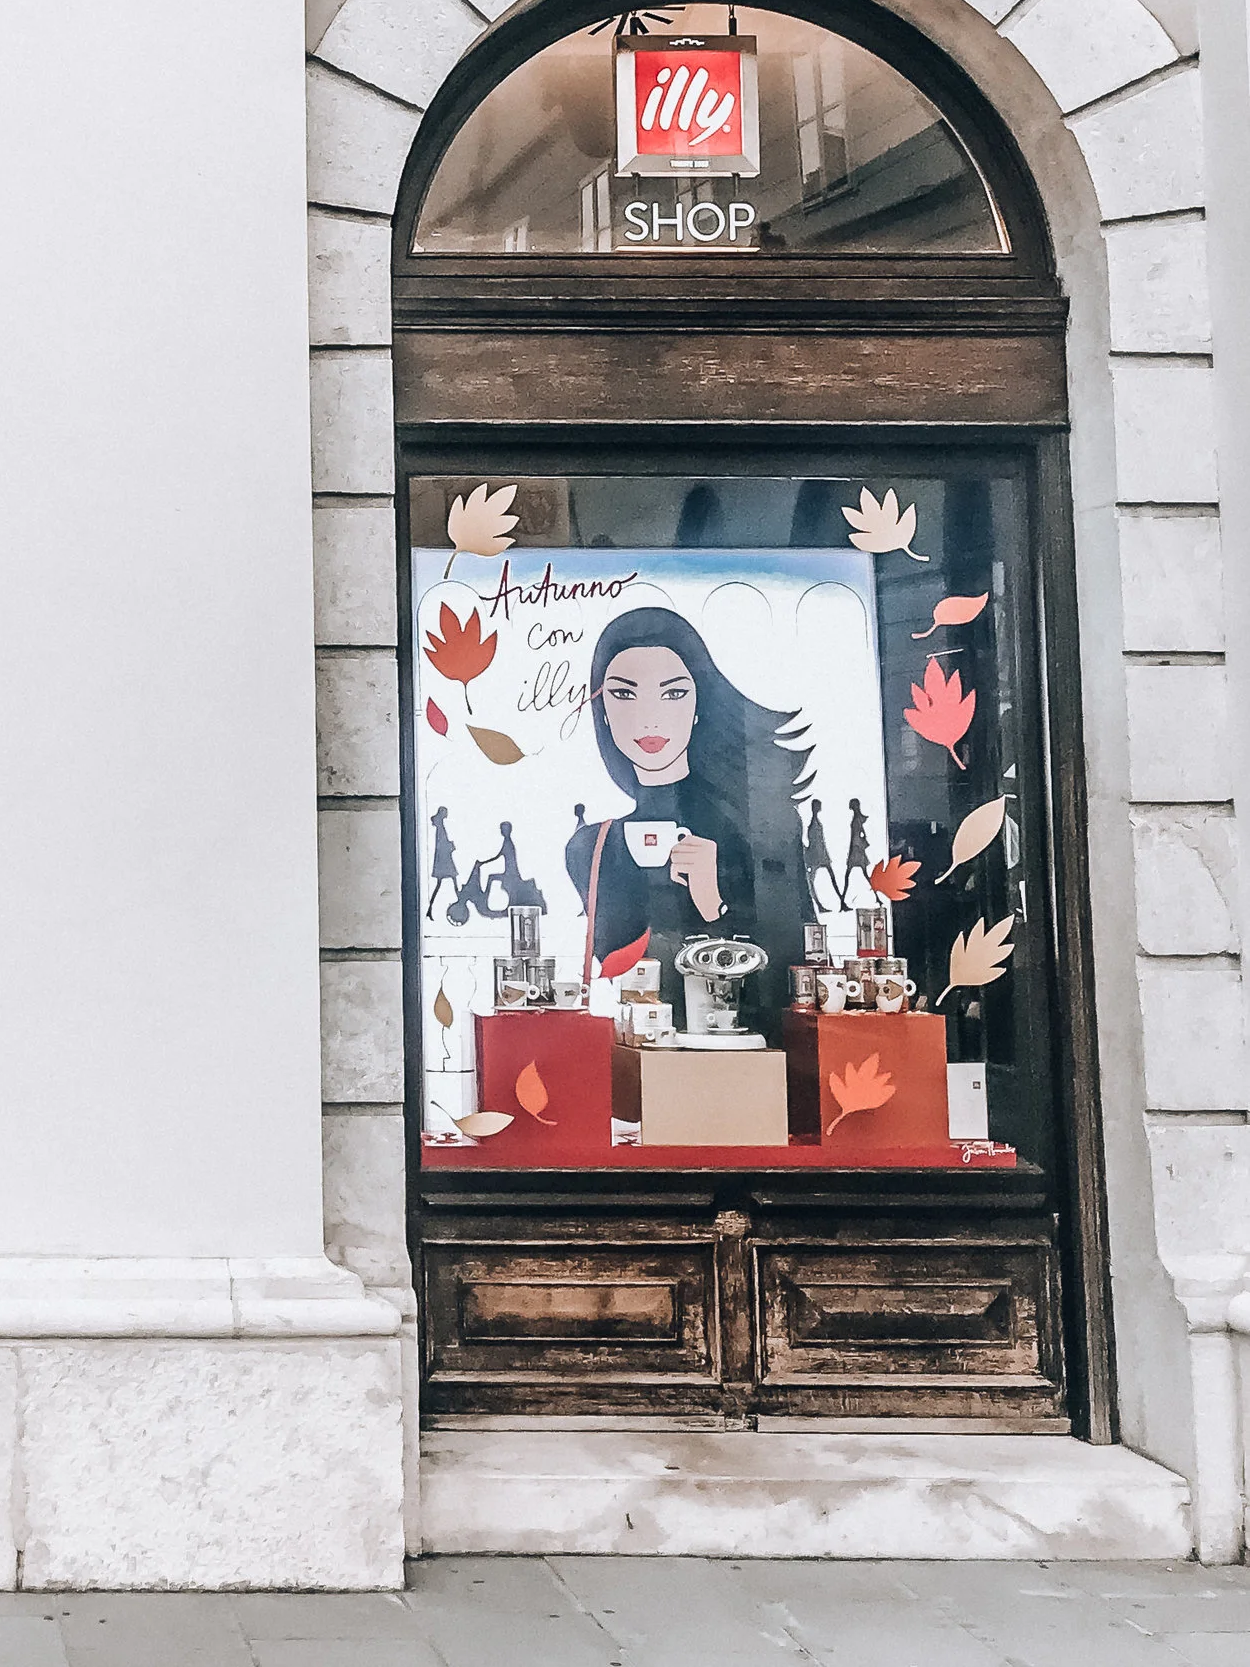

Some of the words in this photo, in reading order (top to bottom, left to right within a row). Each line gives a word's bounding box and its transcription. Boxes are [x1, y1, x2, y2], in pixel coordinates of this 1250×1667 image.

[641, 65, 735, 146] illy
[624, 201, 756, 242] SHOP
[479, 560, 638, 621] Autunno
[517, 660, 591, 742] illy
